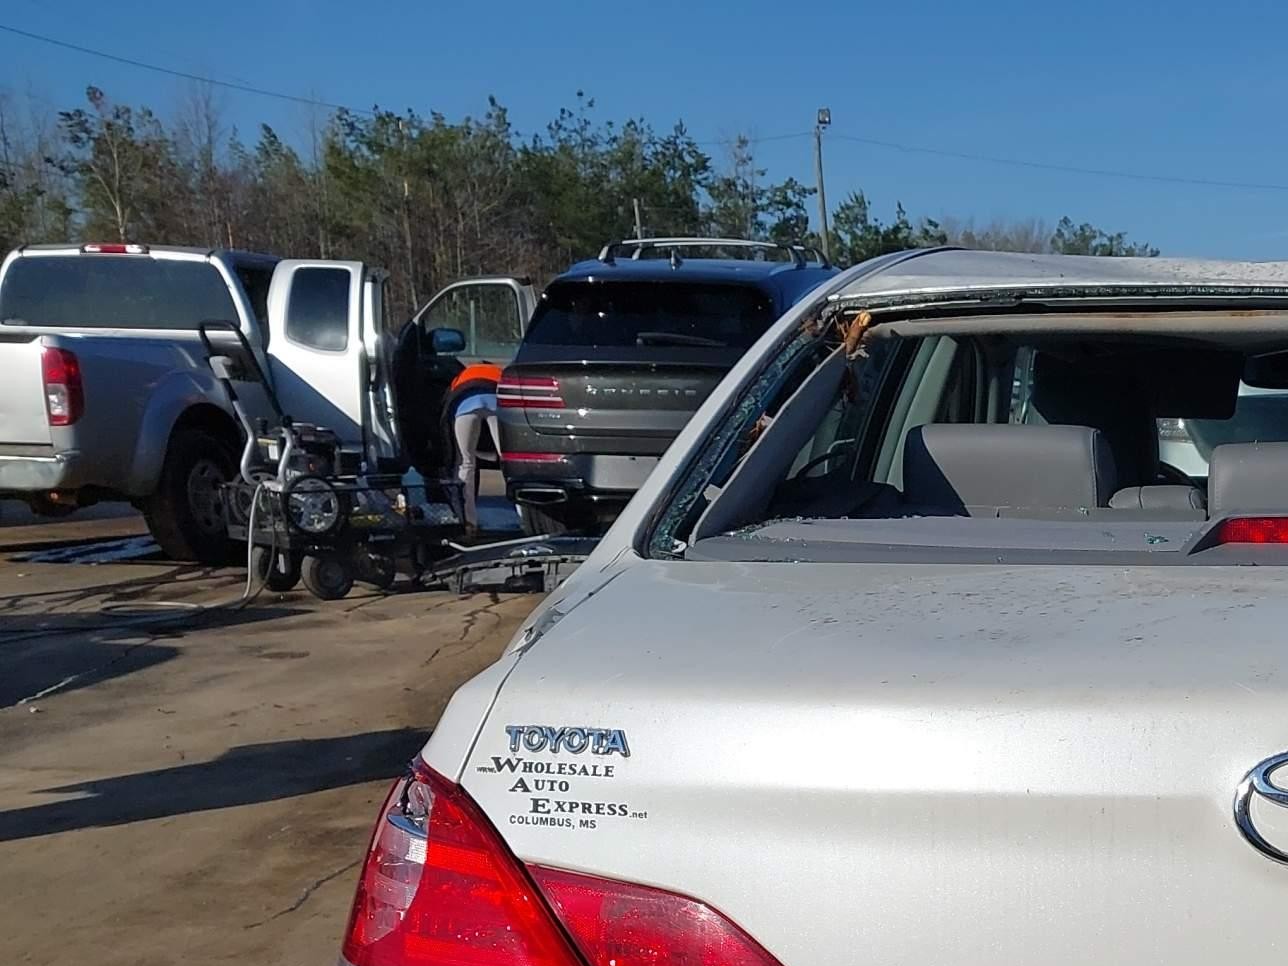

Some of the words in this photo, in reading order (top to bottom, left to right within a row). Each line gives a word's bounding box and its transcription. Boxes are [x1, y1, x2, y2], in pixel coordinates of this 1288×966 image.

[505, 725, 631, 757] TOYOTA
[508, 777, 570, 793] AUTO
[509, 815, 575, 829] COLUMBUS,
[579, 819, 597, 829] MS
